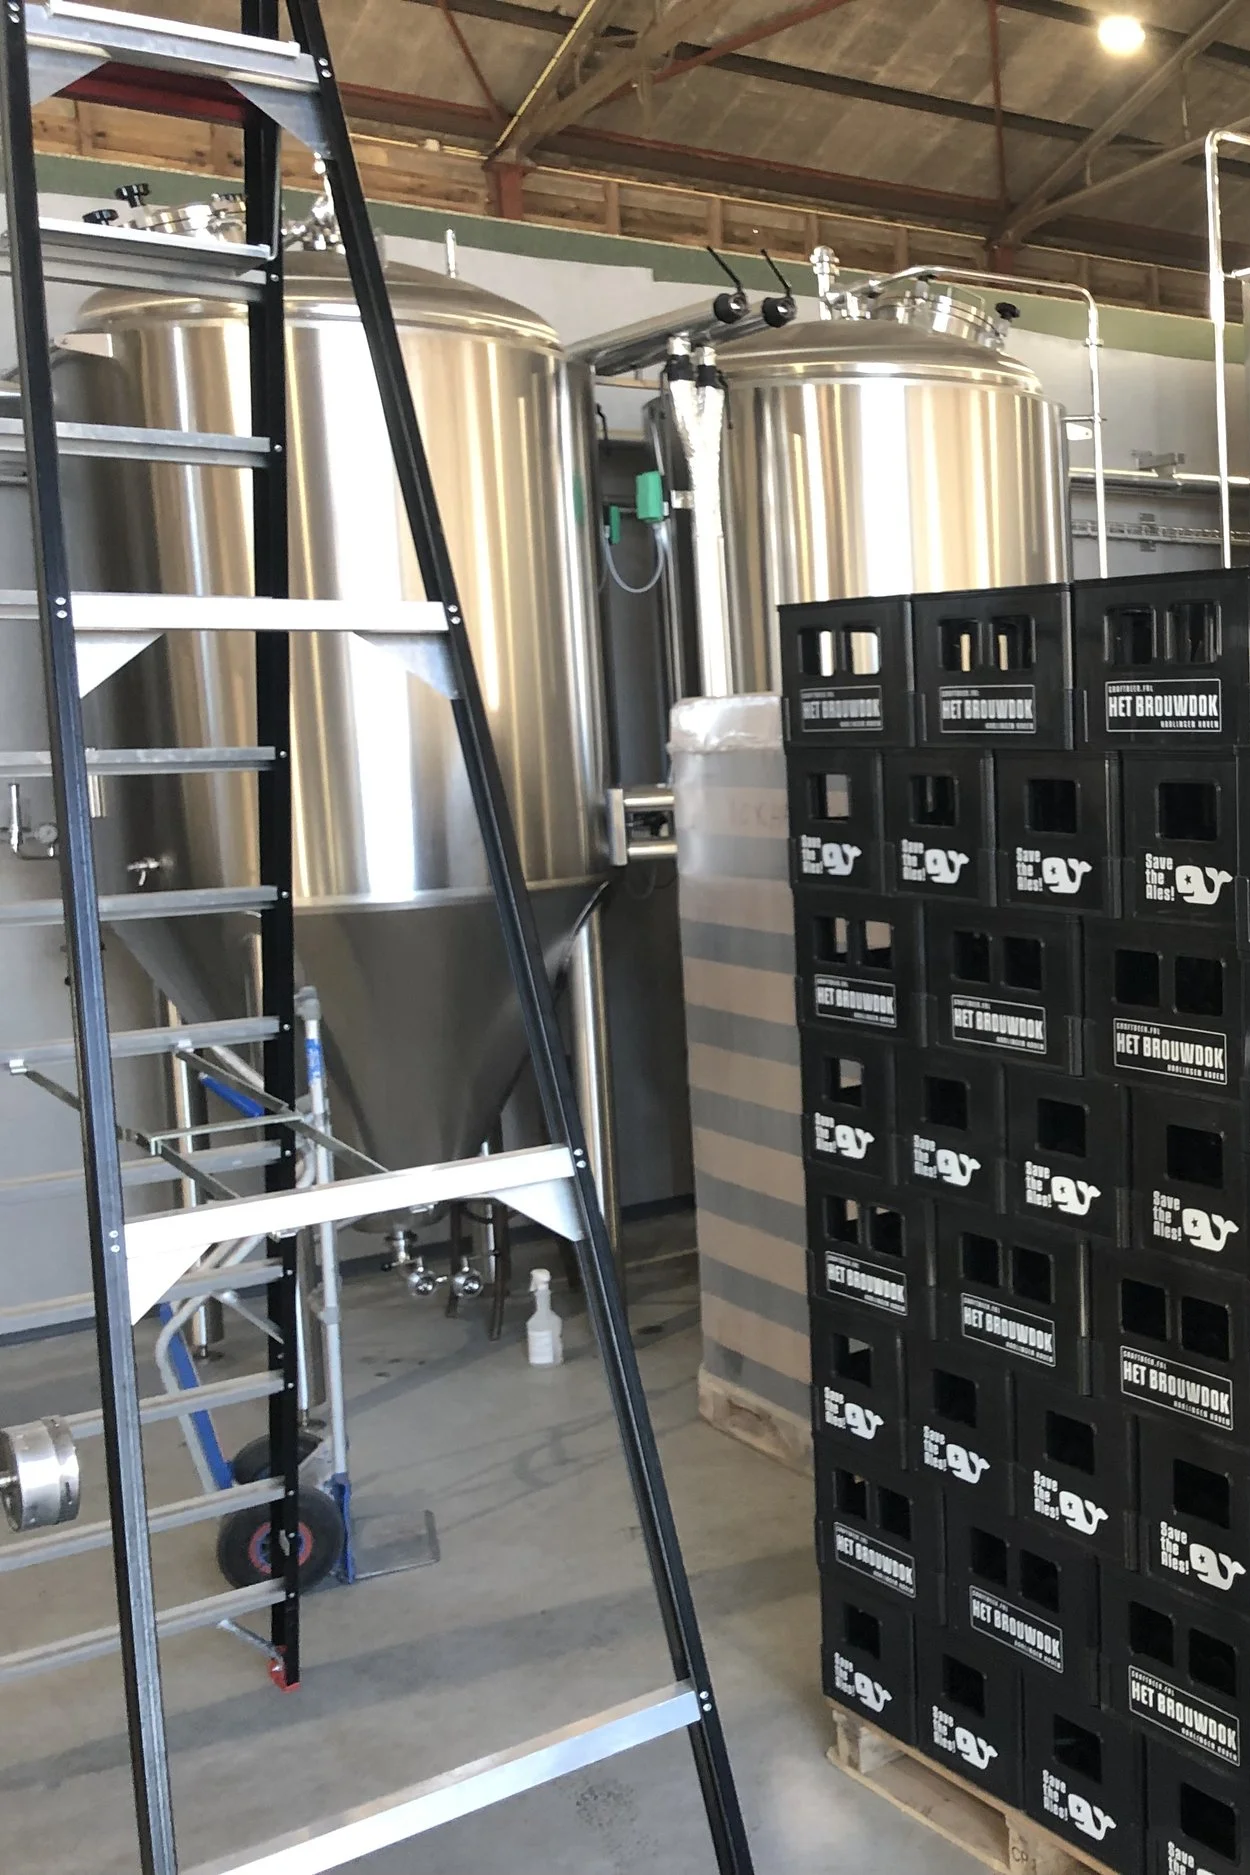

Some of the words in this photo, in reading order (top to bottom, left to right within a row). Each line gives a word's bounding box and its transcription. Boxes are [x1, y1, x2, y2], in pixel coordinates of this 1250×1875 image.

[1108, 695, 1133, 717] HET
[1135, 694, 1218, 717] BROUWDOK
[1015, 847, 1041, 863] Save
[1144, 852, 1173, 870] Save
[1015, 861, 1034, 877] the
[1144, 868, 1165, 885] the
[1145, 883, 1175, 902] Ales!
[1116, 1032, 1140, 1055] HET
[1142, 1036, 1224, 1069] BROUWDOK
[1025, 1160, 1050, 1179] Save
[1025, 1174, 1043, 1192] the
[1152, 1190, 1181, 1211] Save
[1152, 1205, 1172, 1224] the
[1122, 1359, 1147, 1386] HET
[1149, 1368, 1229, 1414] BROUWDOK
[1033, 1470, 1058, 1492] Save
[1033, 1483, 1051, 1503] the
[1159, 1521, 1188, 1545] Save
[1159, 1535, 1179, 1556] the
[1042, 1768, 1067, 1794] Save
[1042, 1782, 1059, 1803] the
[1167, 1840, 1196, 1870] Save
